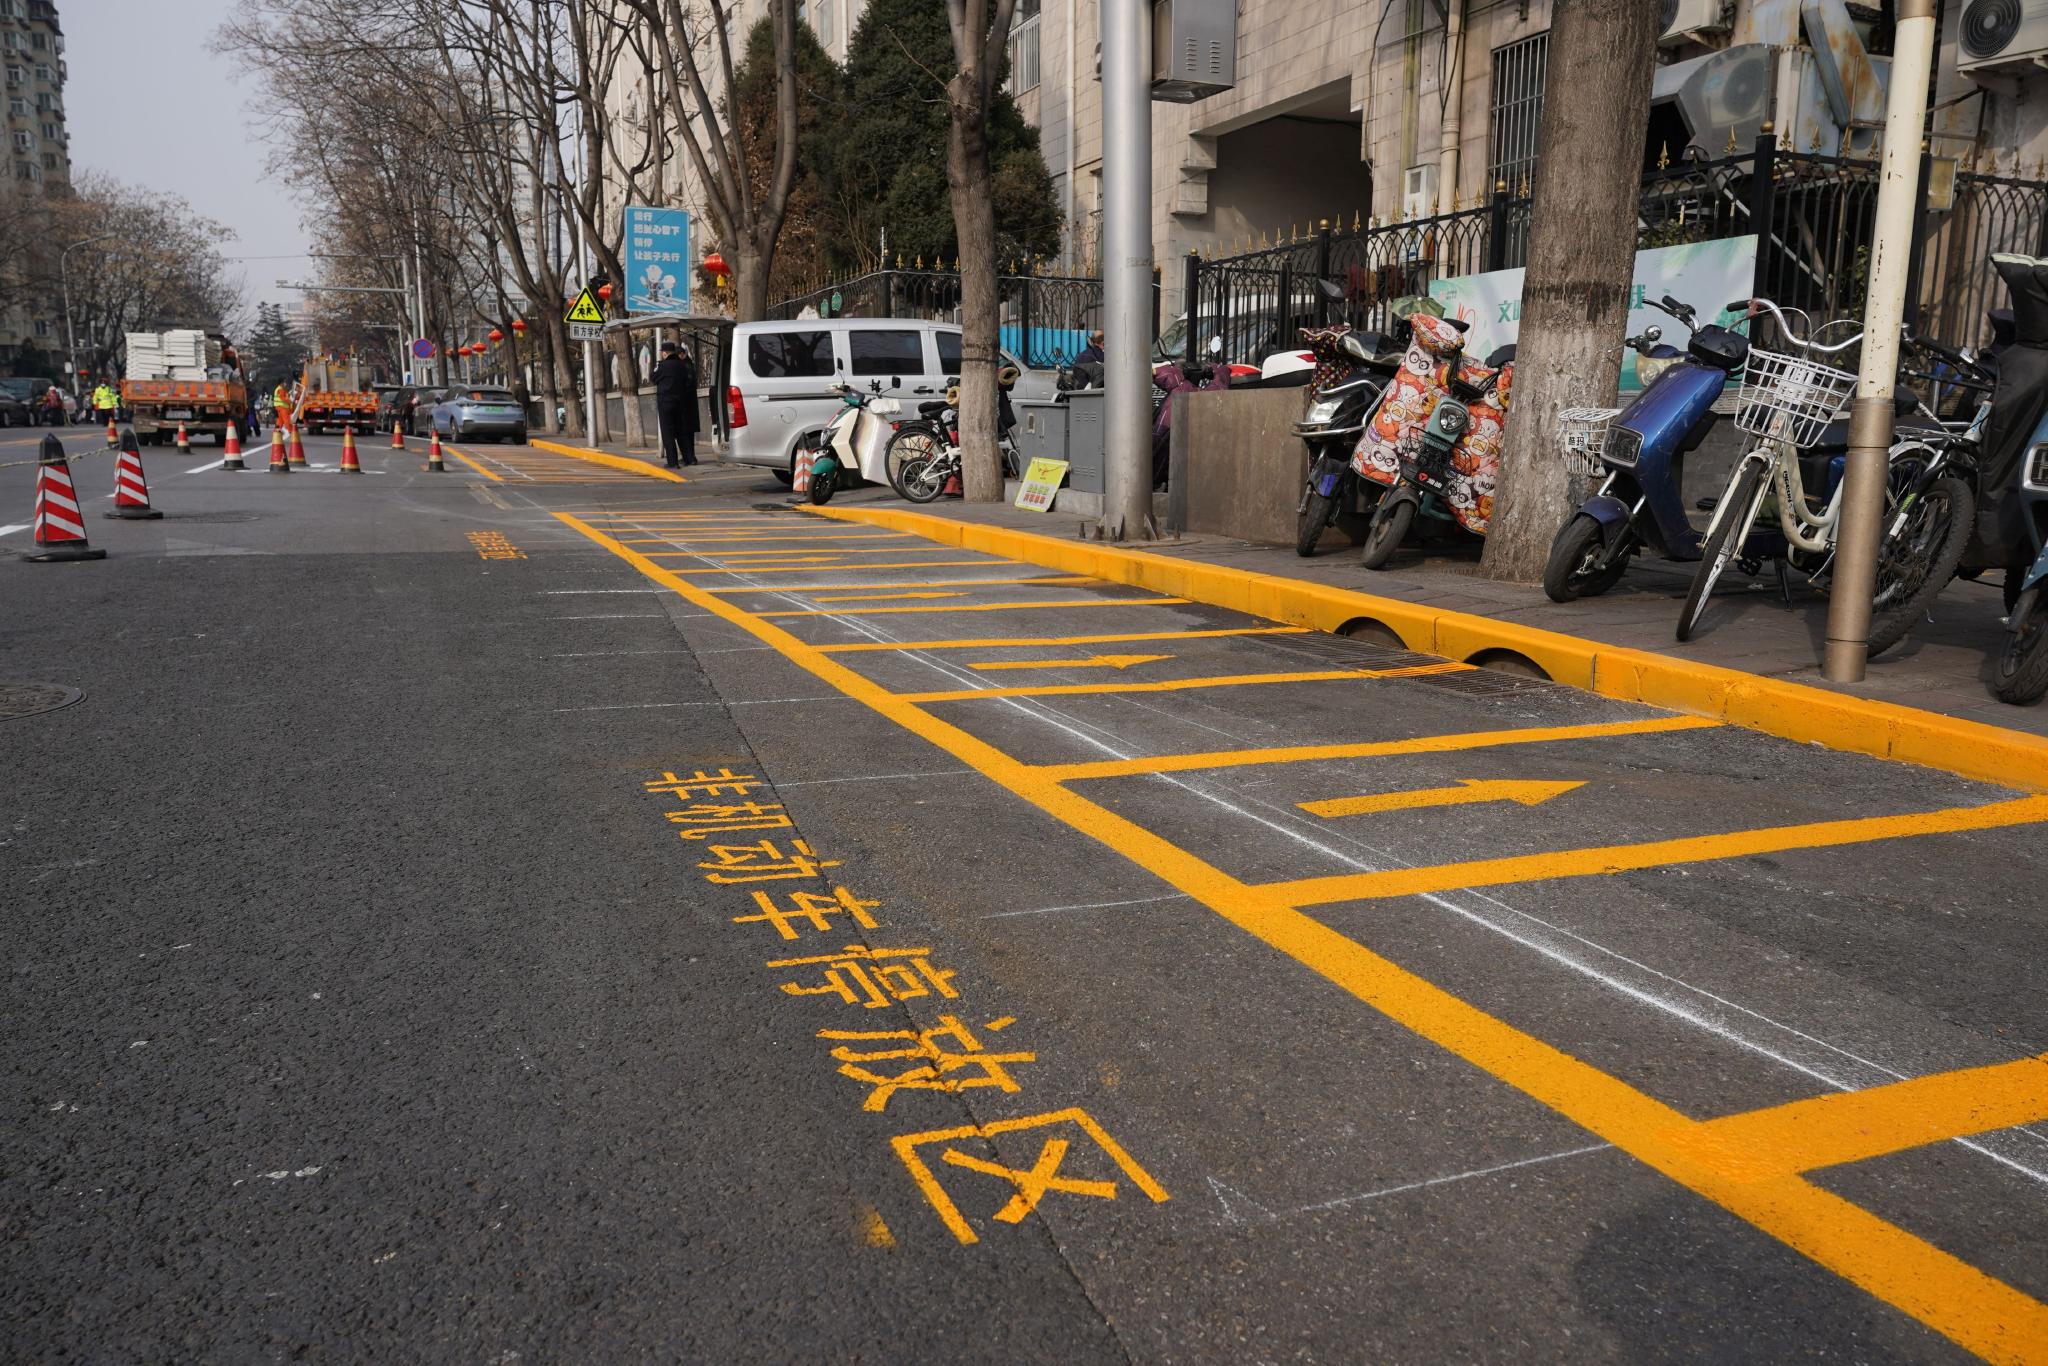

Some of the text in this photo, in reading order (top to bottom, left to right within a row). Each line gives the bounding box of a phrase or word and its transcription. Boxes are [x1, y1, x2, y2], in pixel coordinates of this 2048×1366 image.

[573, 325, 602, 338] 前方学校
[643, 766, 1173, 1246] 非机动车停放区
